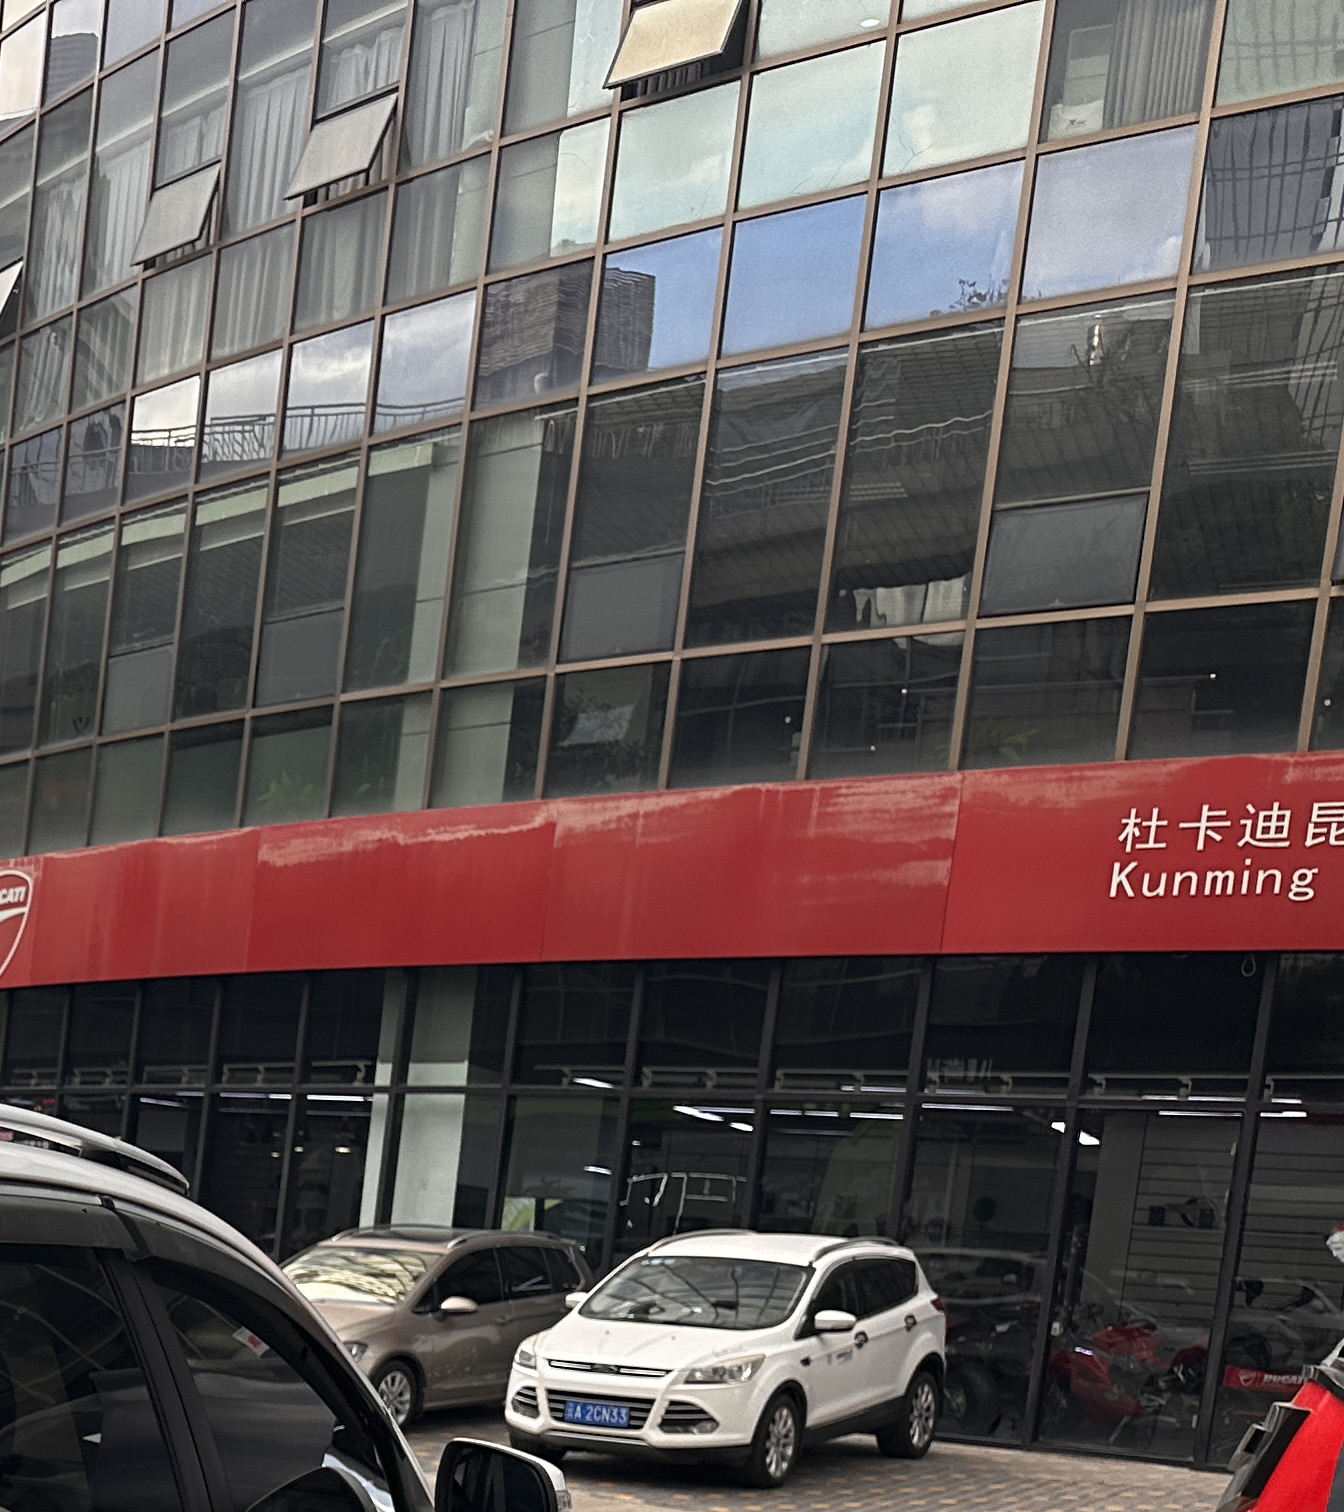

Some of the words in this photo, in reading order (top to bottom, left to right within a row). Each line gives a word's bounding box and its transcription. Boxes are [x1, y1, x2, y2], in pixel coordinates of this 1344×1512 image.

[1118, 801, 1344, 853] 杜卡迪昆
[1109, 858, 1319, 901] Kunming
